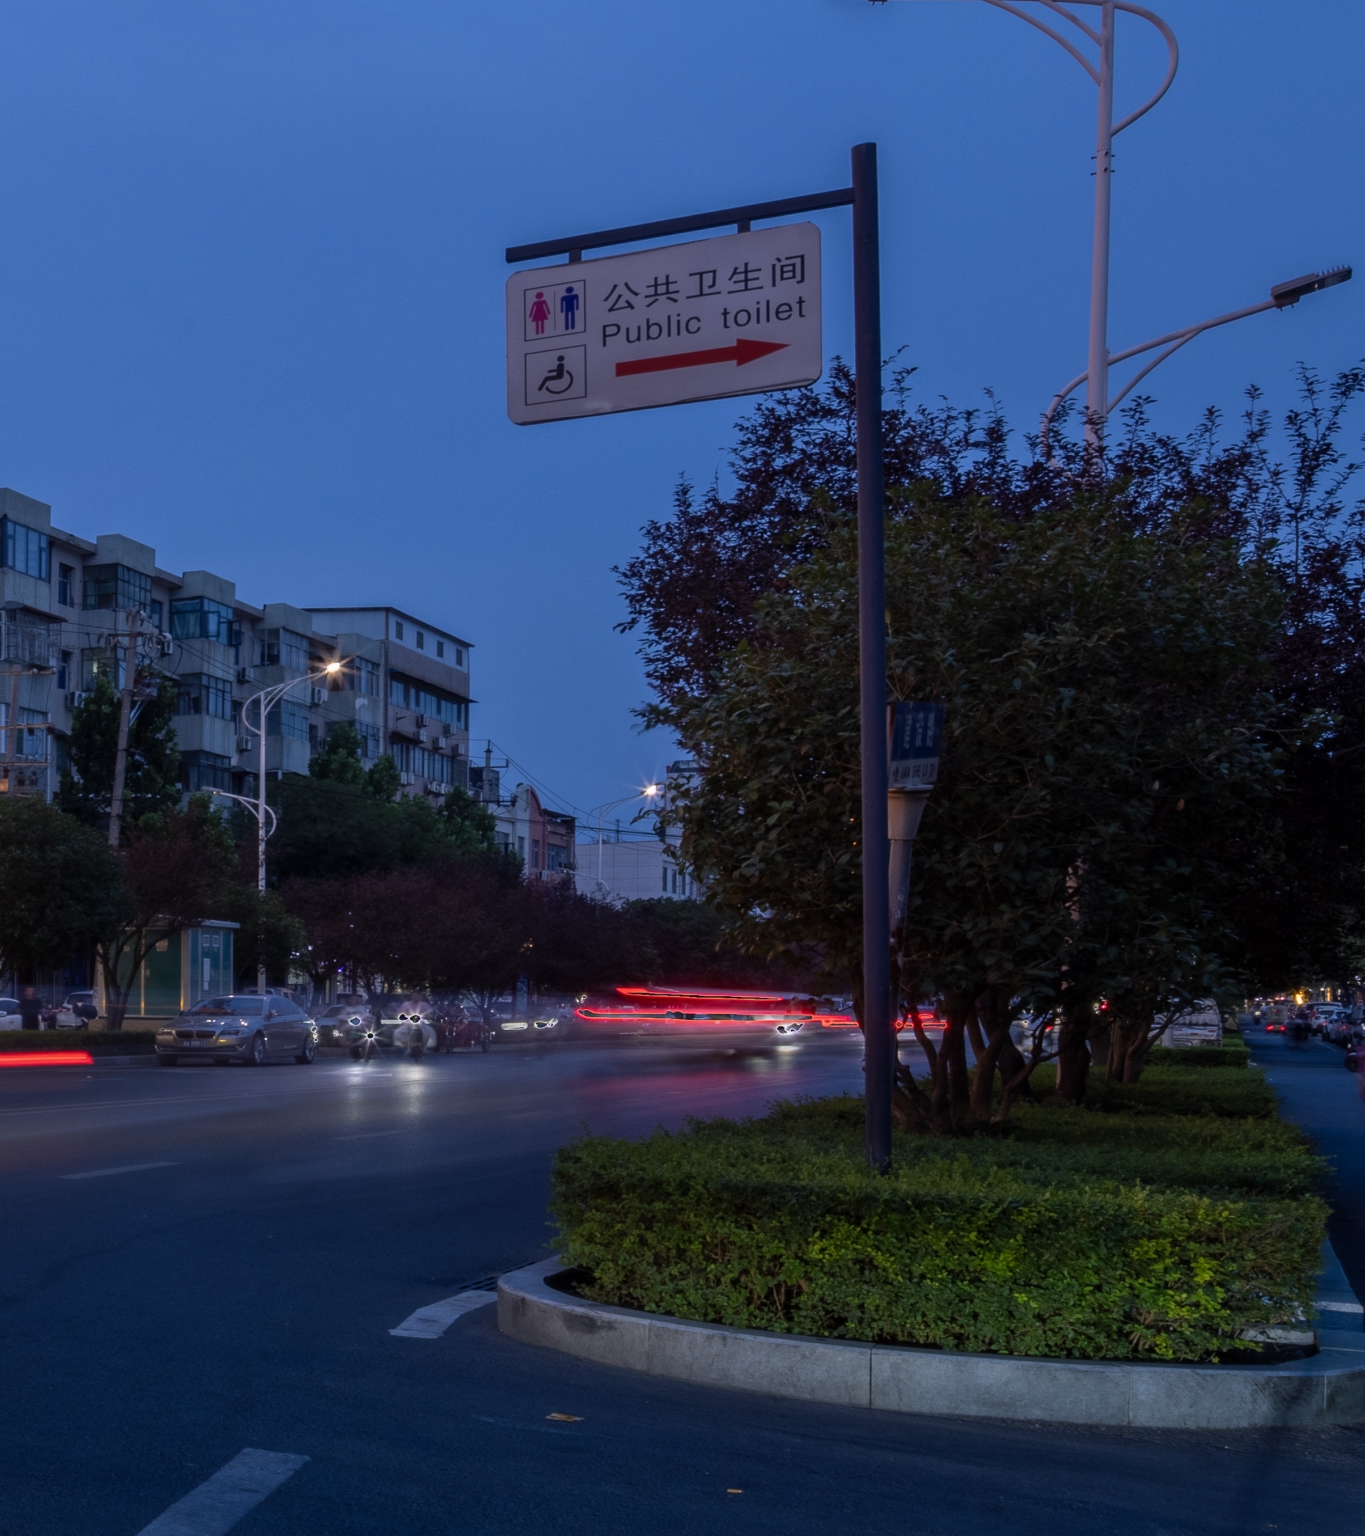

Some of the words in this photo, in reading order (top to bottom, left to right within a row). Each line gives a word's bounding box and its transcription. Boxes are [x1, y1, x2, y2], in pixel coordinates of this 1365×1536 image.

[602, 253, 807, 314] 公共卫生间
[601, 313, 702, 348] Public
[720, 295, 807, 329] toilet
